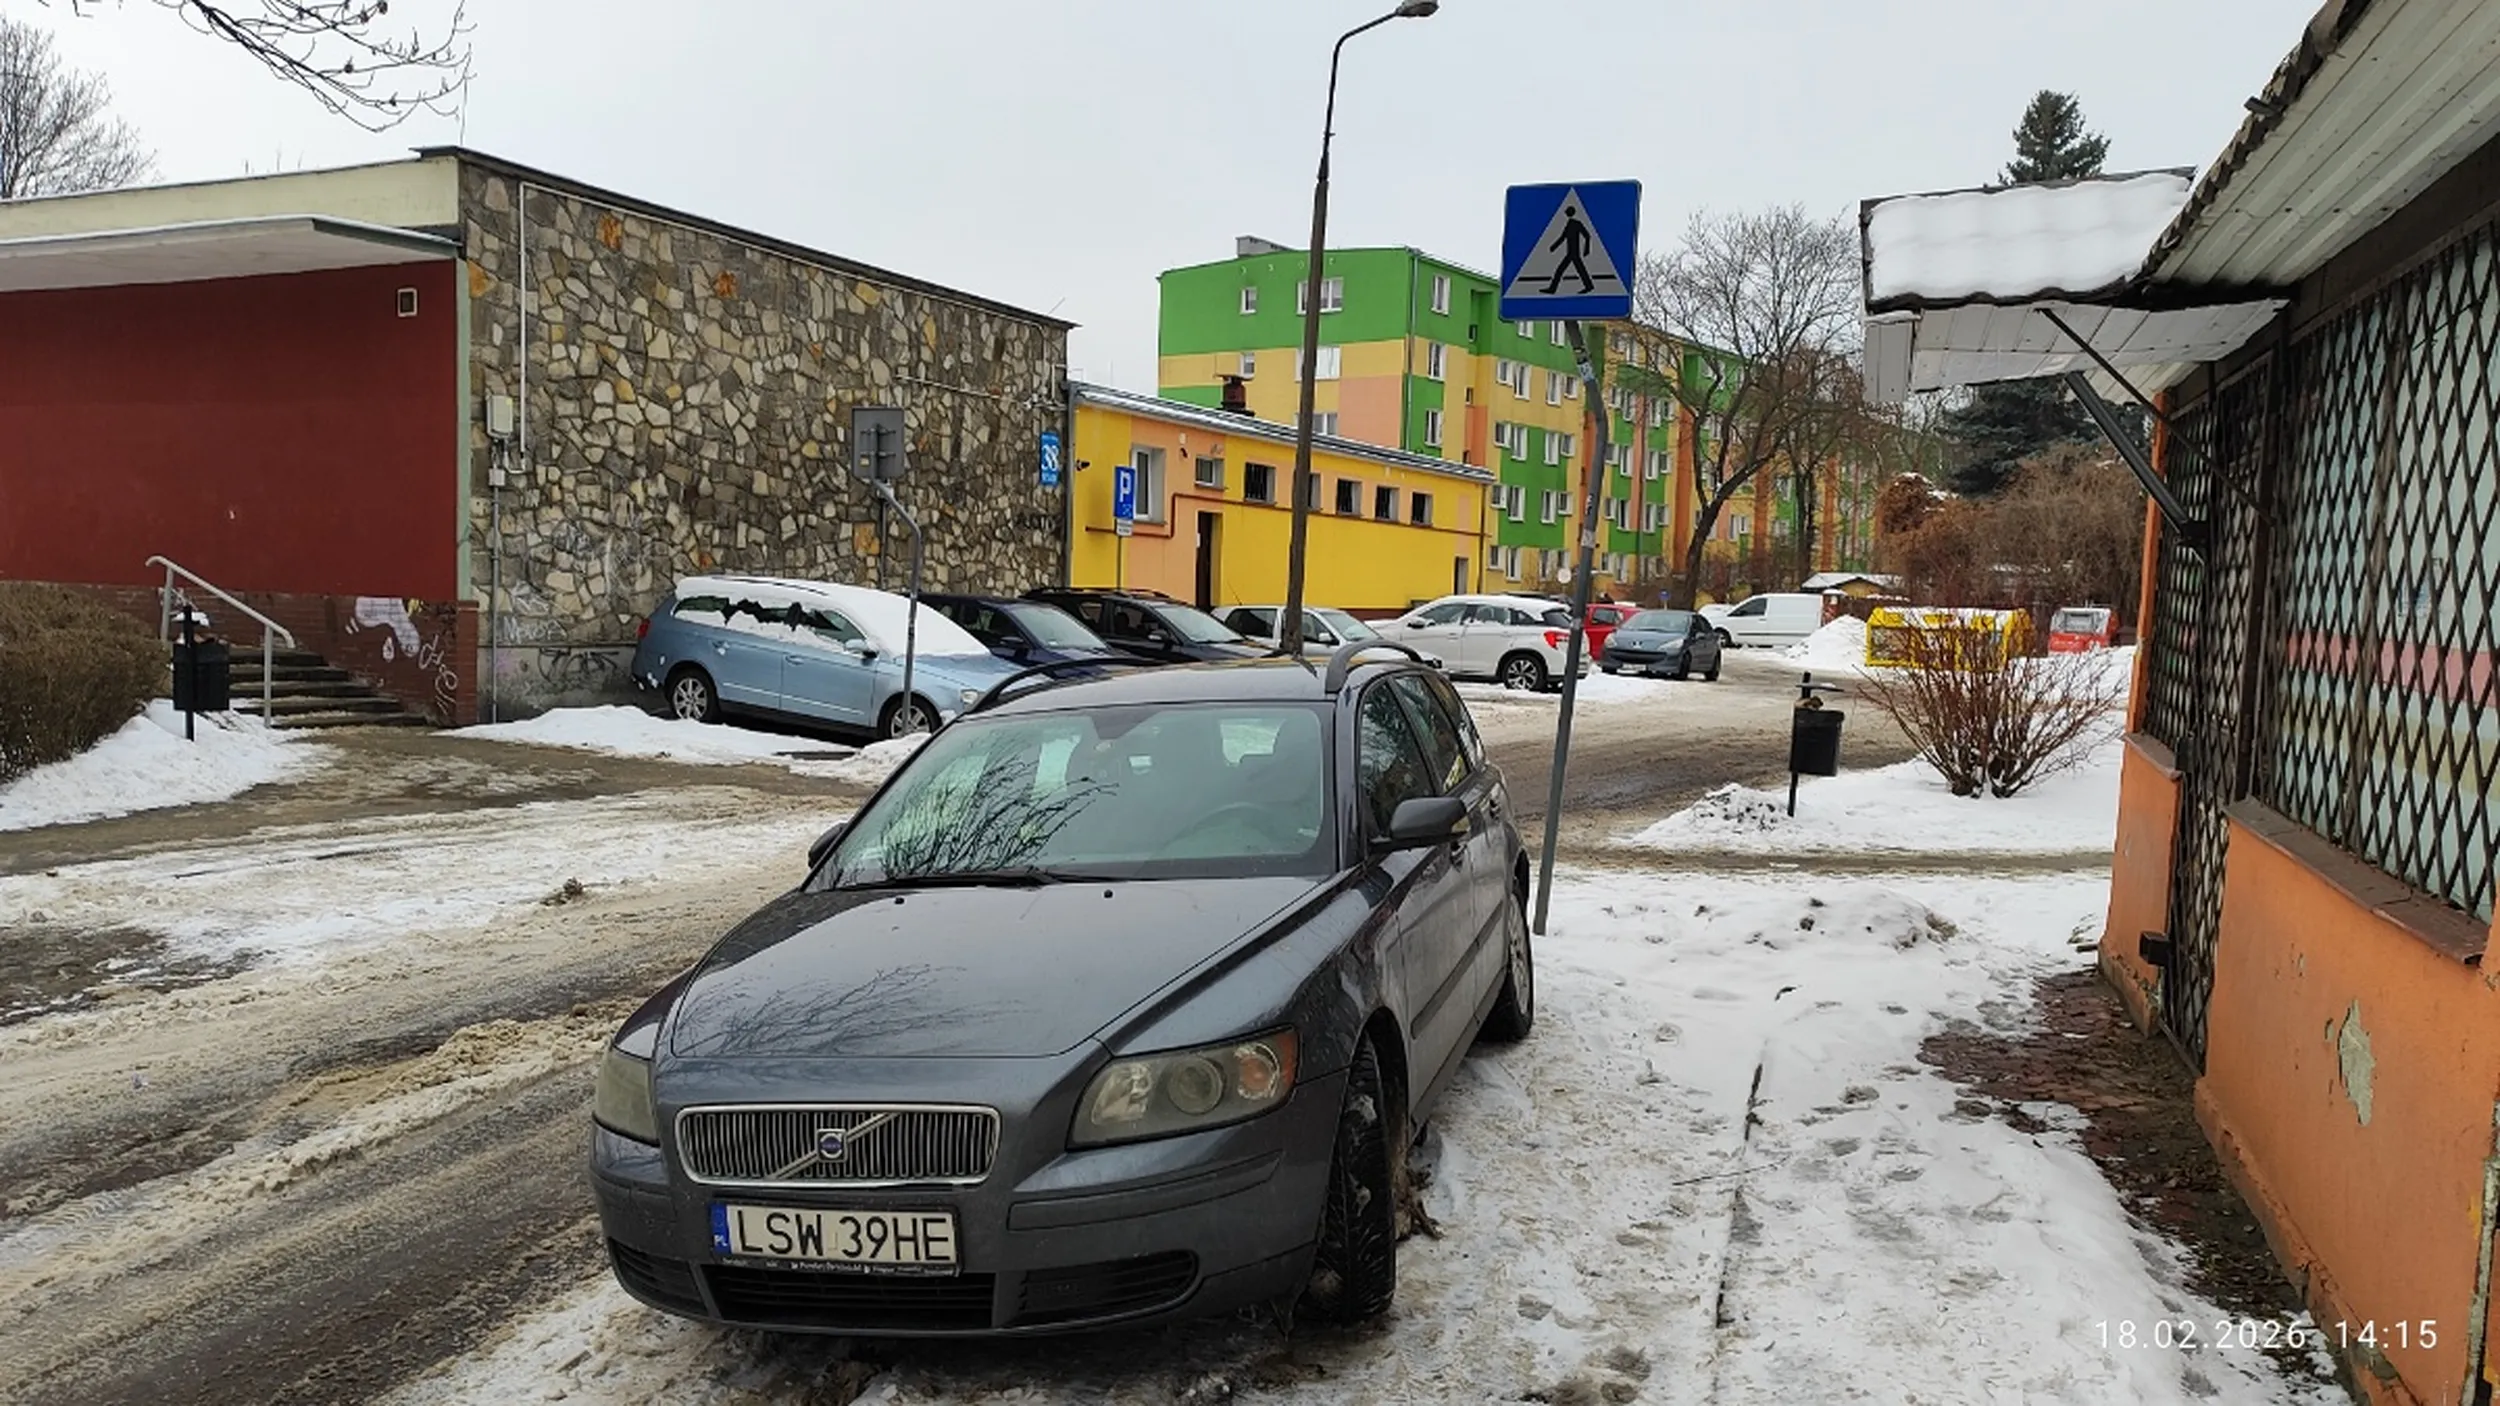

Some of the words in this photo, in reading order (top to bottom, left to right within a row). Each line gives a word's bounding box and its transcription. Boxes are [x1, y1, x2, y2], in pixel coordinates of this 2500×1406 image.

[1120, 471, 1132, 502] P
[714, 1235, 727, 1247] PL
[737, 1210, 824, 1257] LSW
[839, 1216, 951, 1262] 39HE
